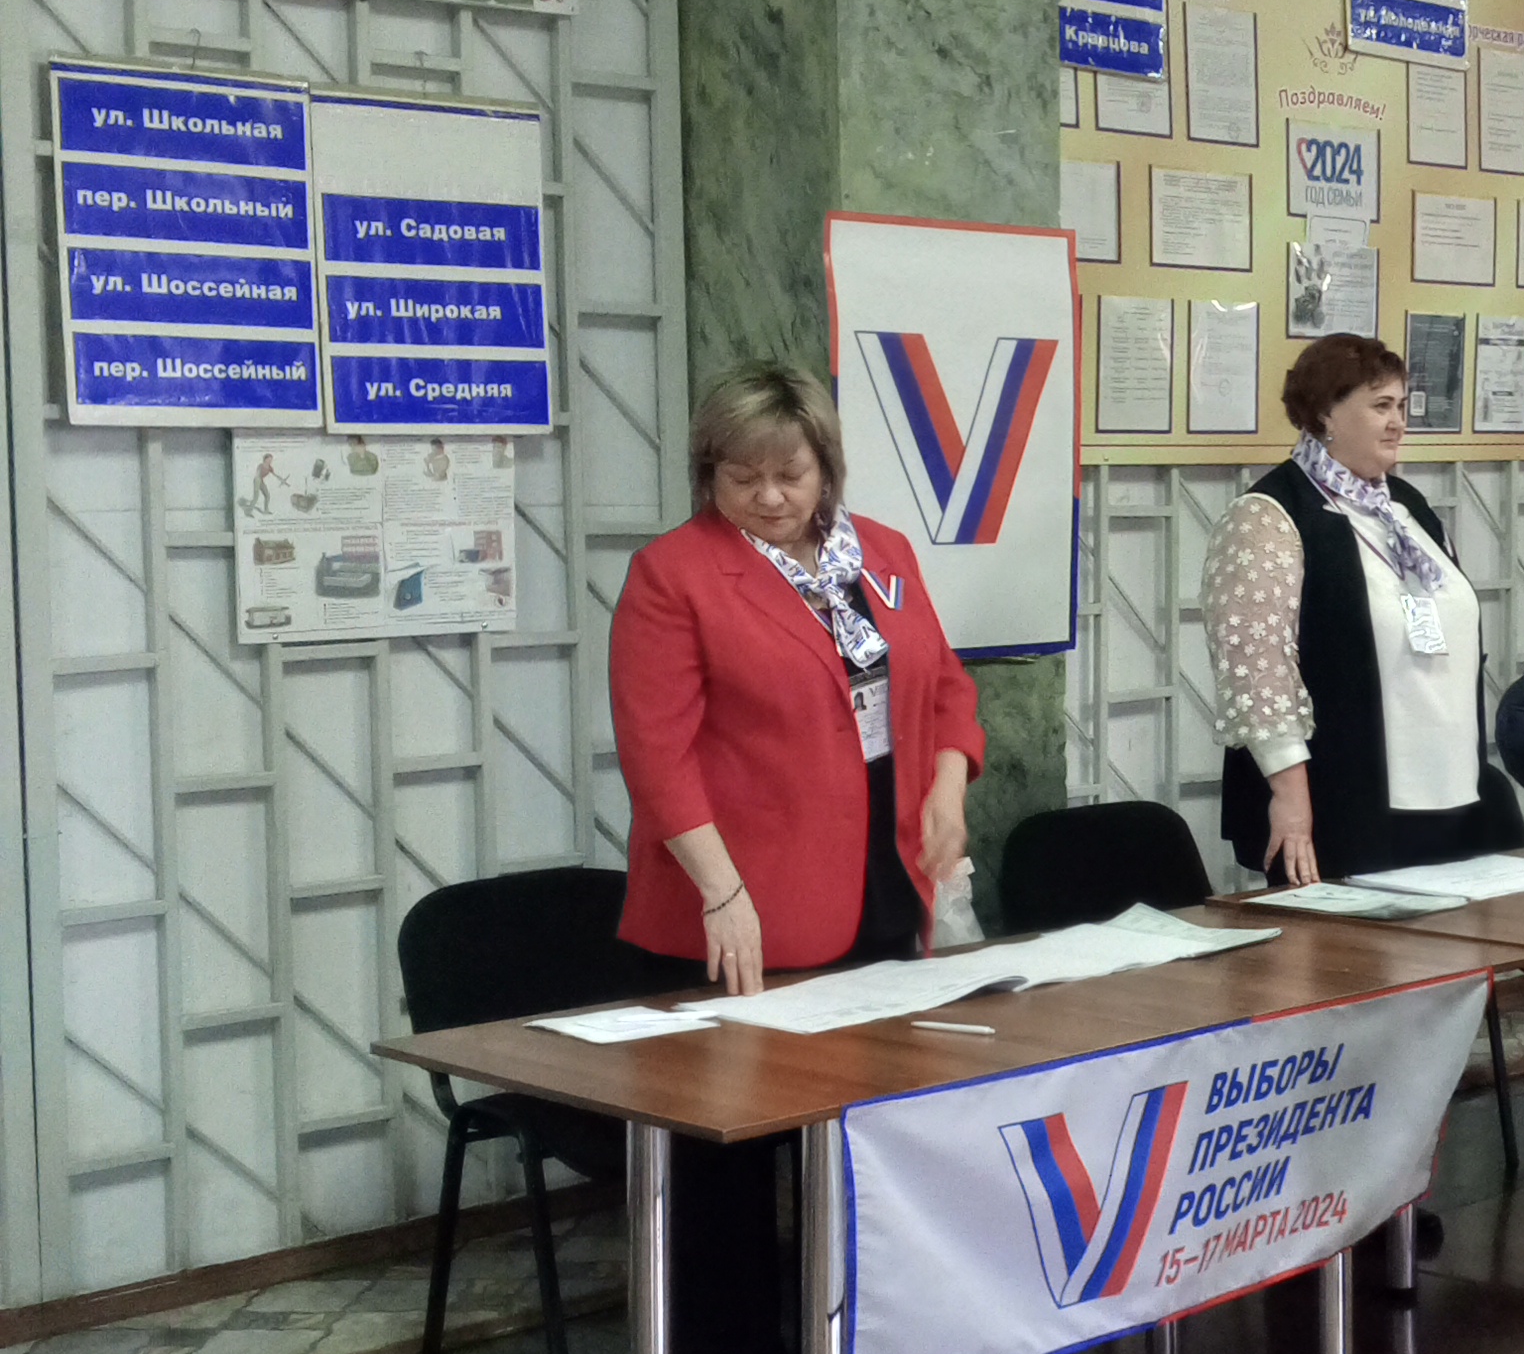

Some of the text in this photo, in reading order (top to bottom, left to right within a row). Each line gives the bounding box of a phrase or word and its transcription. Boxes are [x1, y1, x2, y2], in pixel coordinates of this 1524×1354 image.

[1065, 25, 1149, 55] Кравцова
[1279, 85, 1386, 120] Поздравляем!
[92, 104, 283, 140] ул. Школьная
[1306, 138, 1363, 185] 2024
[76, 187, 294, 219] пер. Школьный
[1306, 186, 1362, 207] ГОД СЕМЬИ
[354, 218, 506, 243] ул. Садовая
[91, 273, 297, 301] ул. Шоссейная
[346, 299, 502, 323] ул. Широкая
[93, 358, 306, 382] пер. Шоссейный
[366, 378, 513, 403] ул. Средняя
[1206, 1043, 1343, 1114] ВЫБОРЫ
[1188, 1083, 1377, 1174] ПРЕЗИДЕНТА
[1169, 1156, 1290, 1234] РОССИИ
[1222, 1210, 1288, 1263] МАРТА
[1288, 1189, 1347, 1247] 2024
